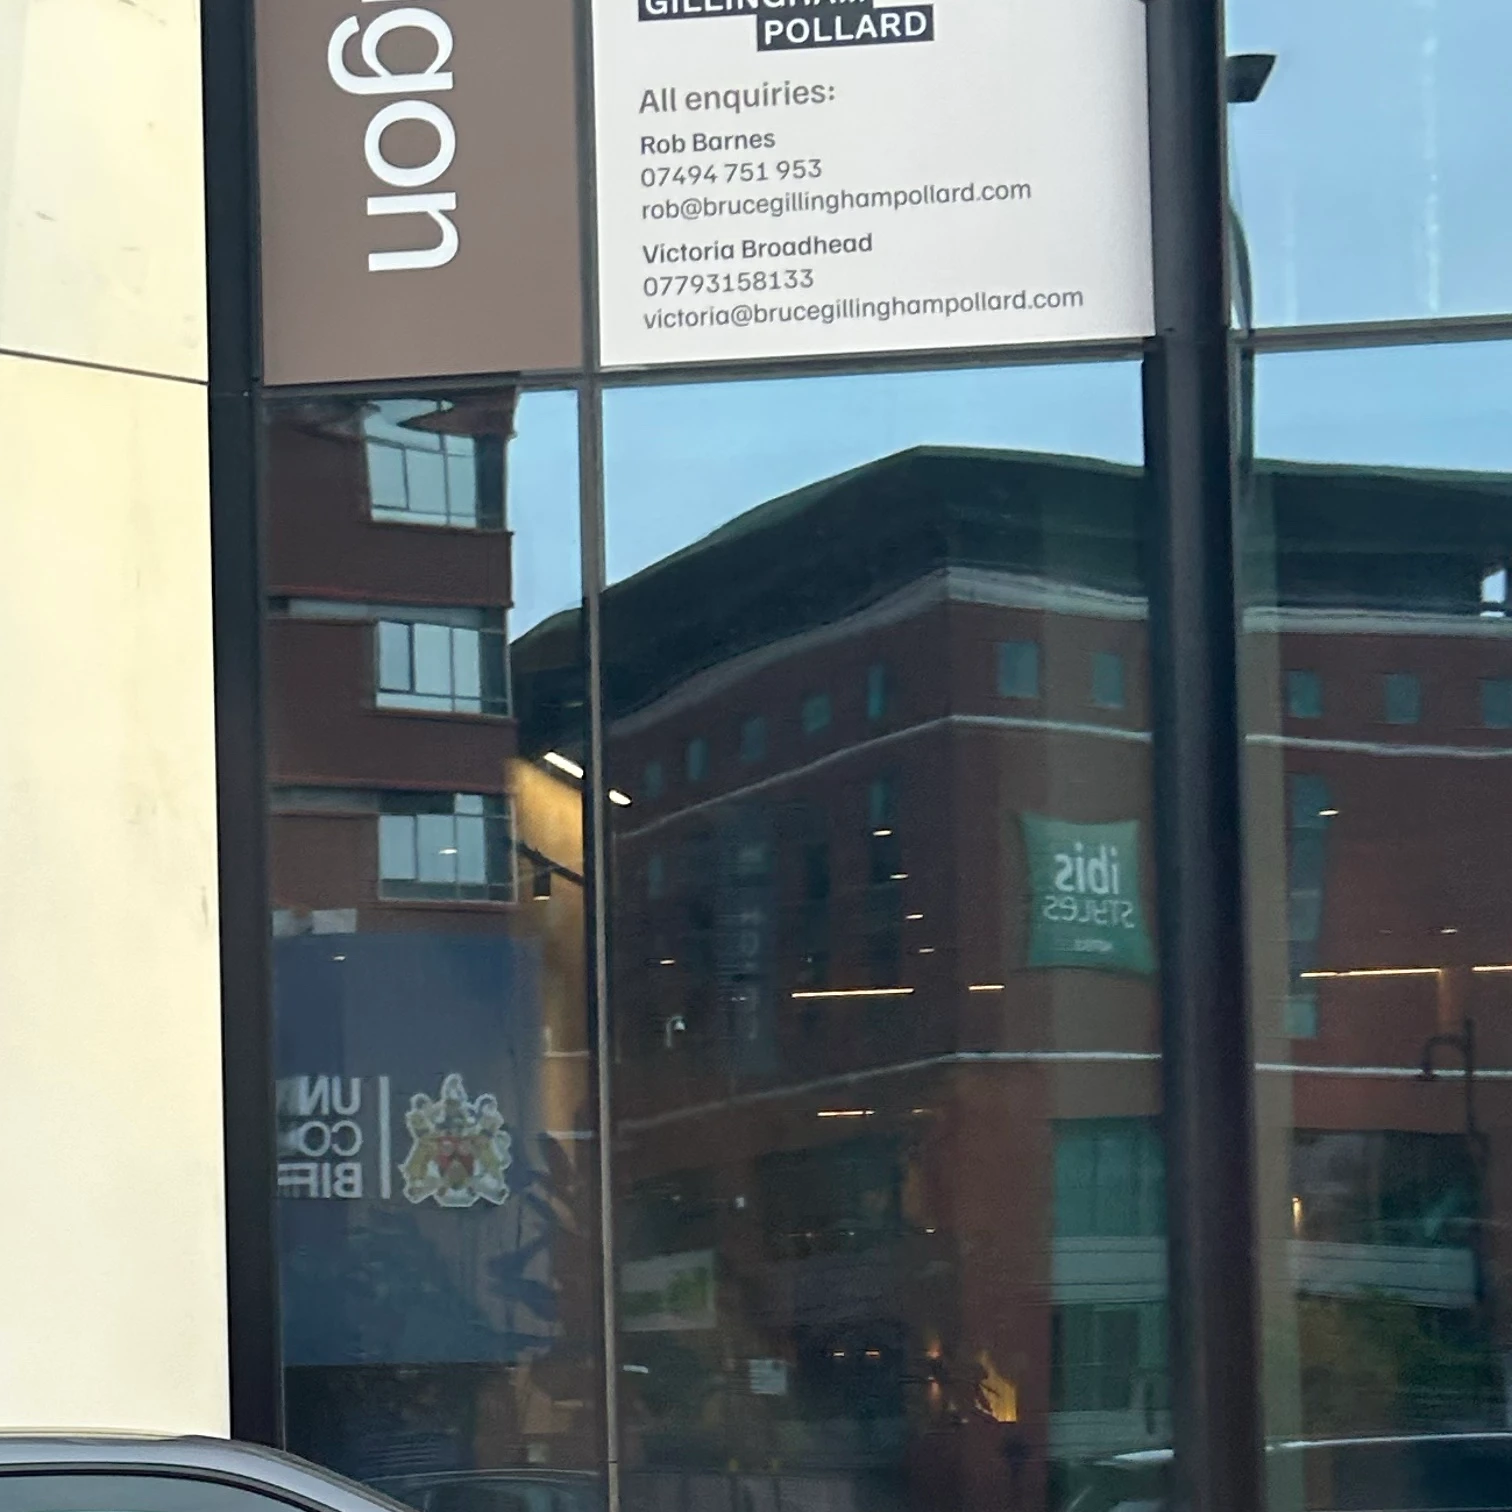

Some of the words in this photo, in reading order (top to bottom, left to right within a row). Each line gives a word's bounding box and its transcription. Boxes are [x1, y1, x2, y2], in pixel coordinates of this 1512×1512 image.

[764, 11, 928, 45] POLLARD
[639, 87, 677, 114] All
[685, 81, 836, 114] enquiries:
[327, 0, 459, 271] gon
[640, 134, 686, 155] Rob
[692, 132, 776, 153] Barnes
[640, 164, 718, 188] 07494
[724, 162, 769, 183] 751
[776, 158, 823, 181] 953
[641, 180, 1033, 221] rob@brucegillinghampollard.com
[642, 239, 735, 265] Victoria
[741, 232, 874, 260] Broadhead
[643, 268, 815, 297] 07793158133
[643, 288, 1084, 330] victoria@brucegillinghampollard.com
